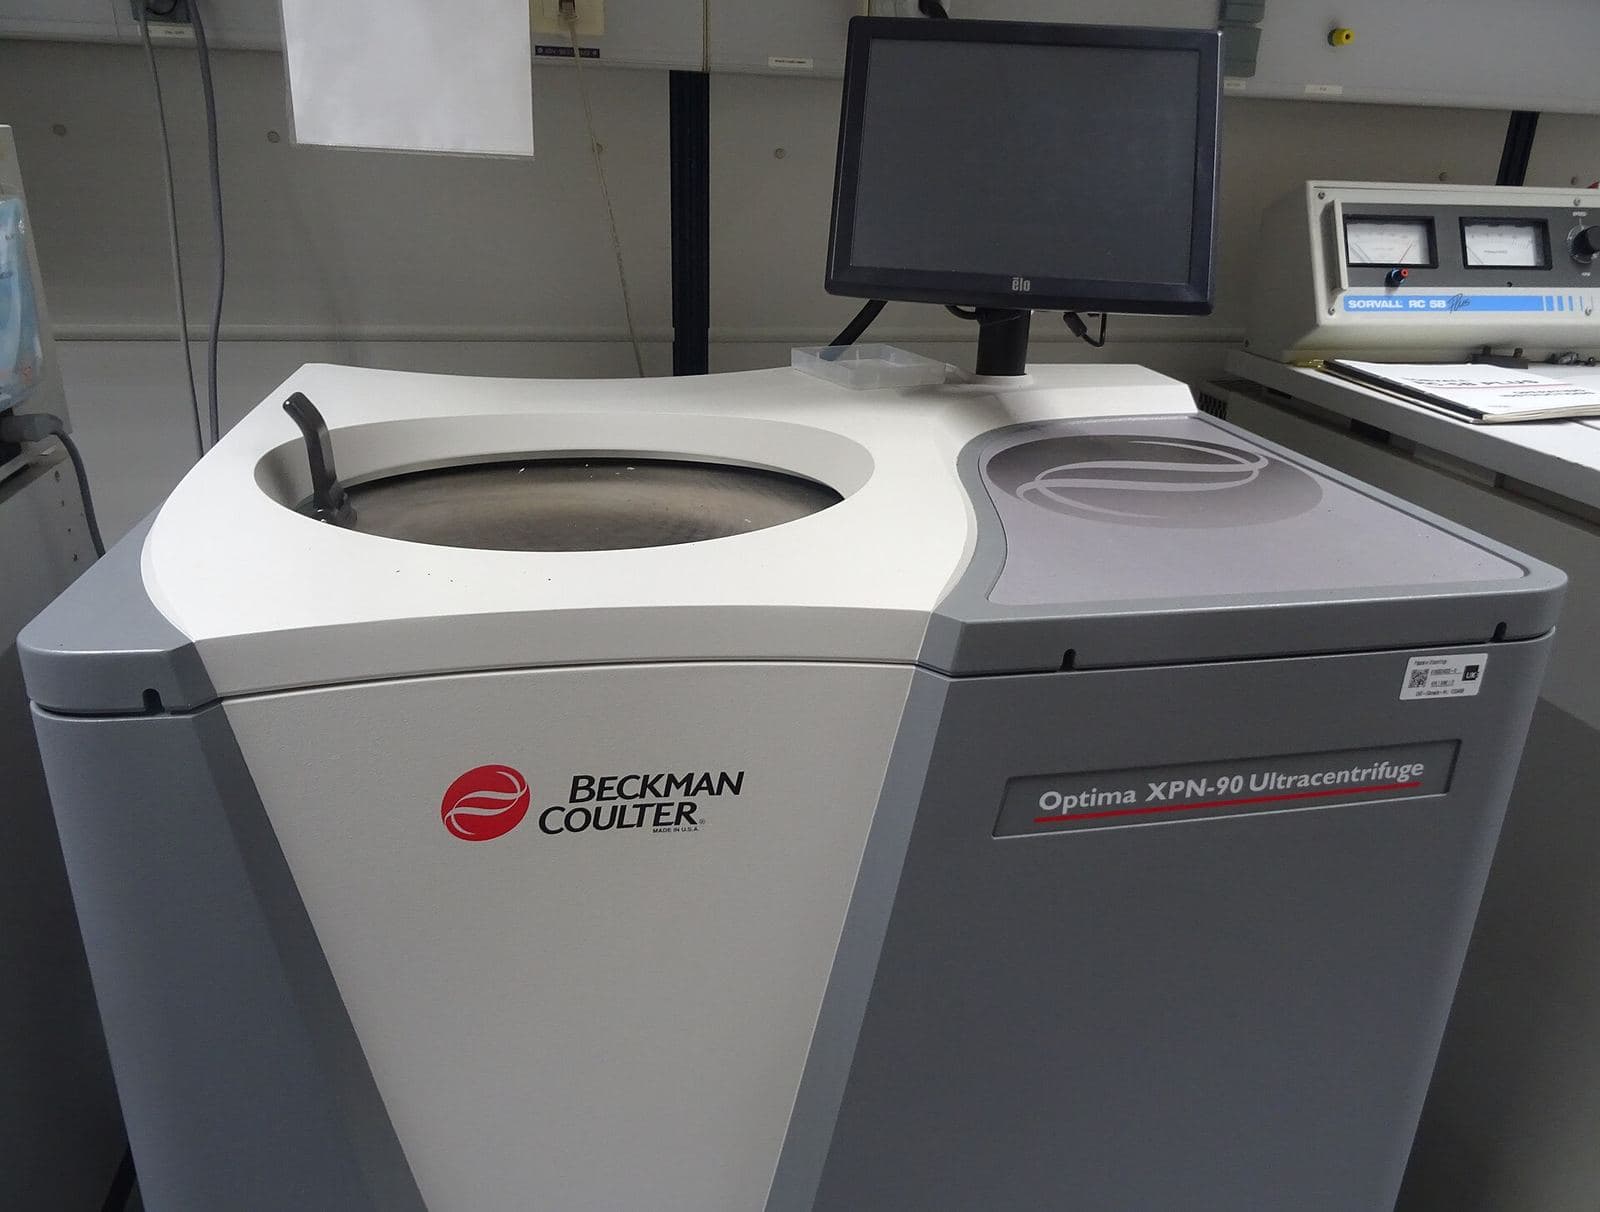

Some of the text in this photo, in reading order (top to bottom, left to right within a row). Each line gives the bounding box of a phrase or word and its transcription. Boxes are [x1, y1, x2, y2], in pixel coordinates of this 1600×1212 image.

[1347, 299, 1403, 309] SORVALL
[1408, 299, 1426, 309] RC
[568, 771, 745, 803] BECKMAN
[1038, 760, 1425, 814] Optima XPN-90 Ultracentrifuge
[538, 801, 698, 835] COULTER
